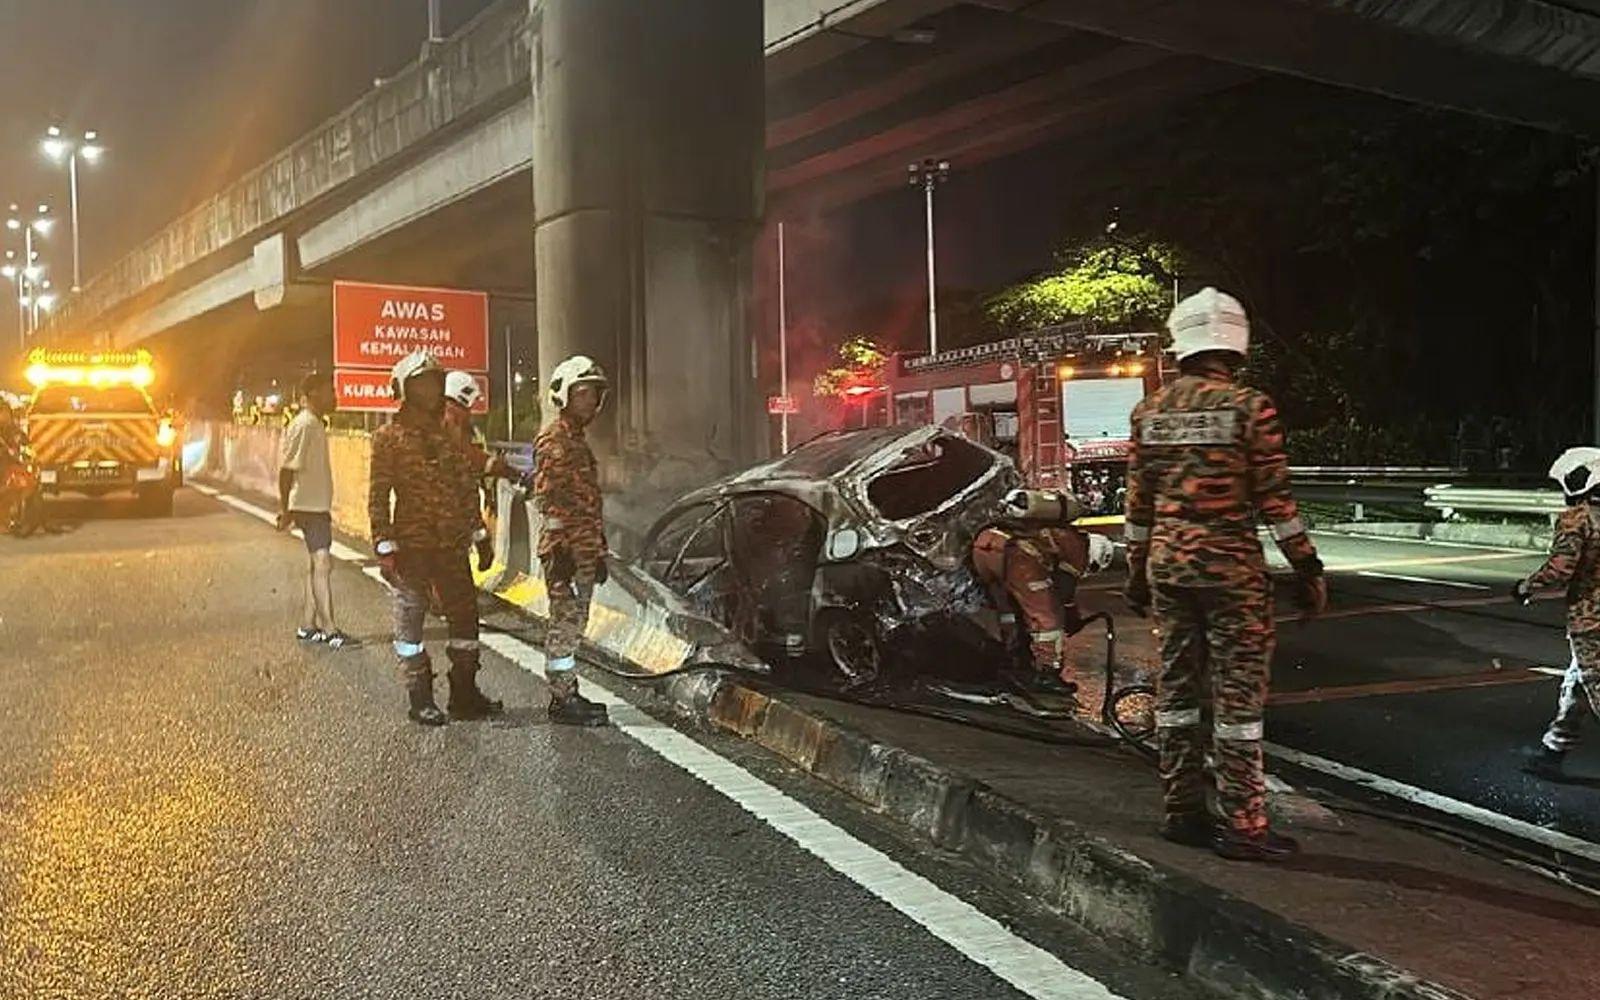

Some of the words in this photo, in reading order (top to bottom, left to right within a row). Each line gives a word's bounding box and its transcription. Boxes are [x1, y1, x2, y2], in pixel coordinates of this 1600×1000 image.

[381, 300, 445, 321] AWAS
[375, 325, 451, 341] KAWASAN
[360, 341, 465, 358] KEMALANGAN
